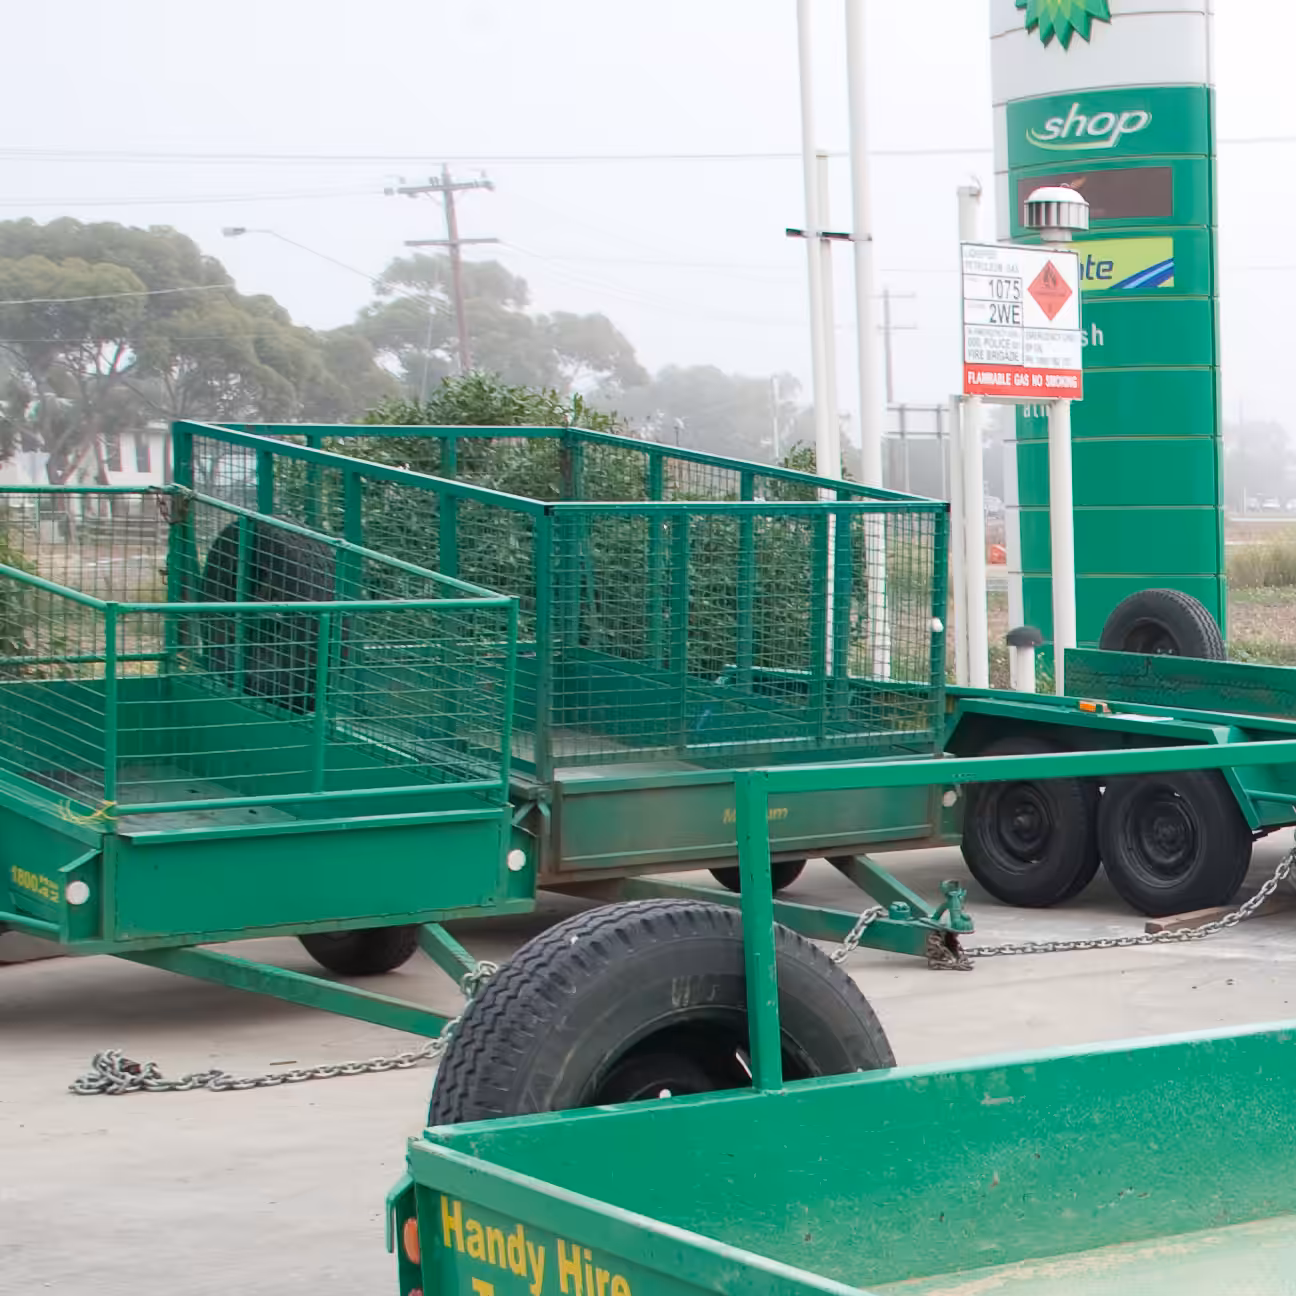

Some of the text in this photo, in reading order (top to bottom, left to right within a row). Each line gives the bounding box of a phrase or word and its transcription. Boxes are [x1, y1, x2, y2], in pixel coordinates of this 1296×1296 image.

[1042, 102, 1152, 148] shop
[989, 279, 1021, 300] 1075
[989, 303, 1021, 325] 2WE
[1014, 374, 1030, 387] GAS
[1031, 375, 1043, 387] NO
[440, 1195, 546, 1296] Handy
